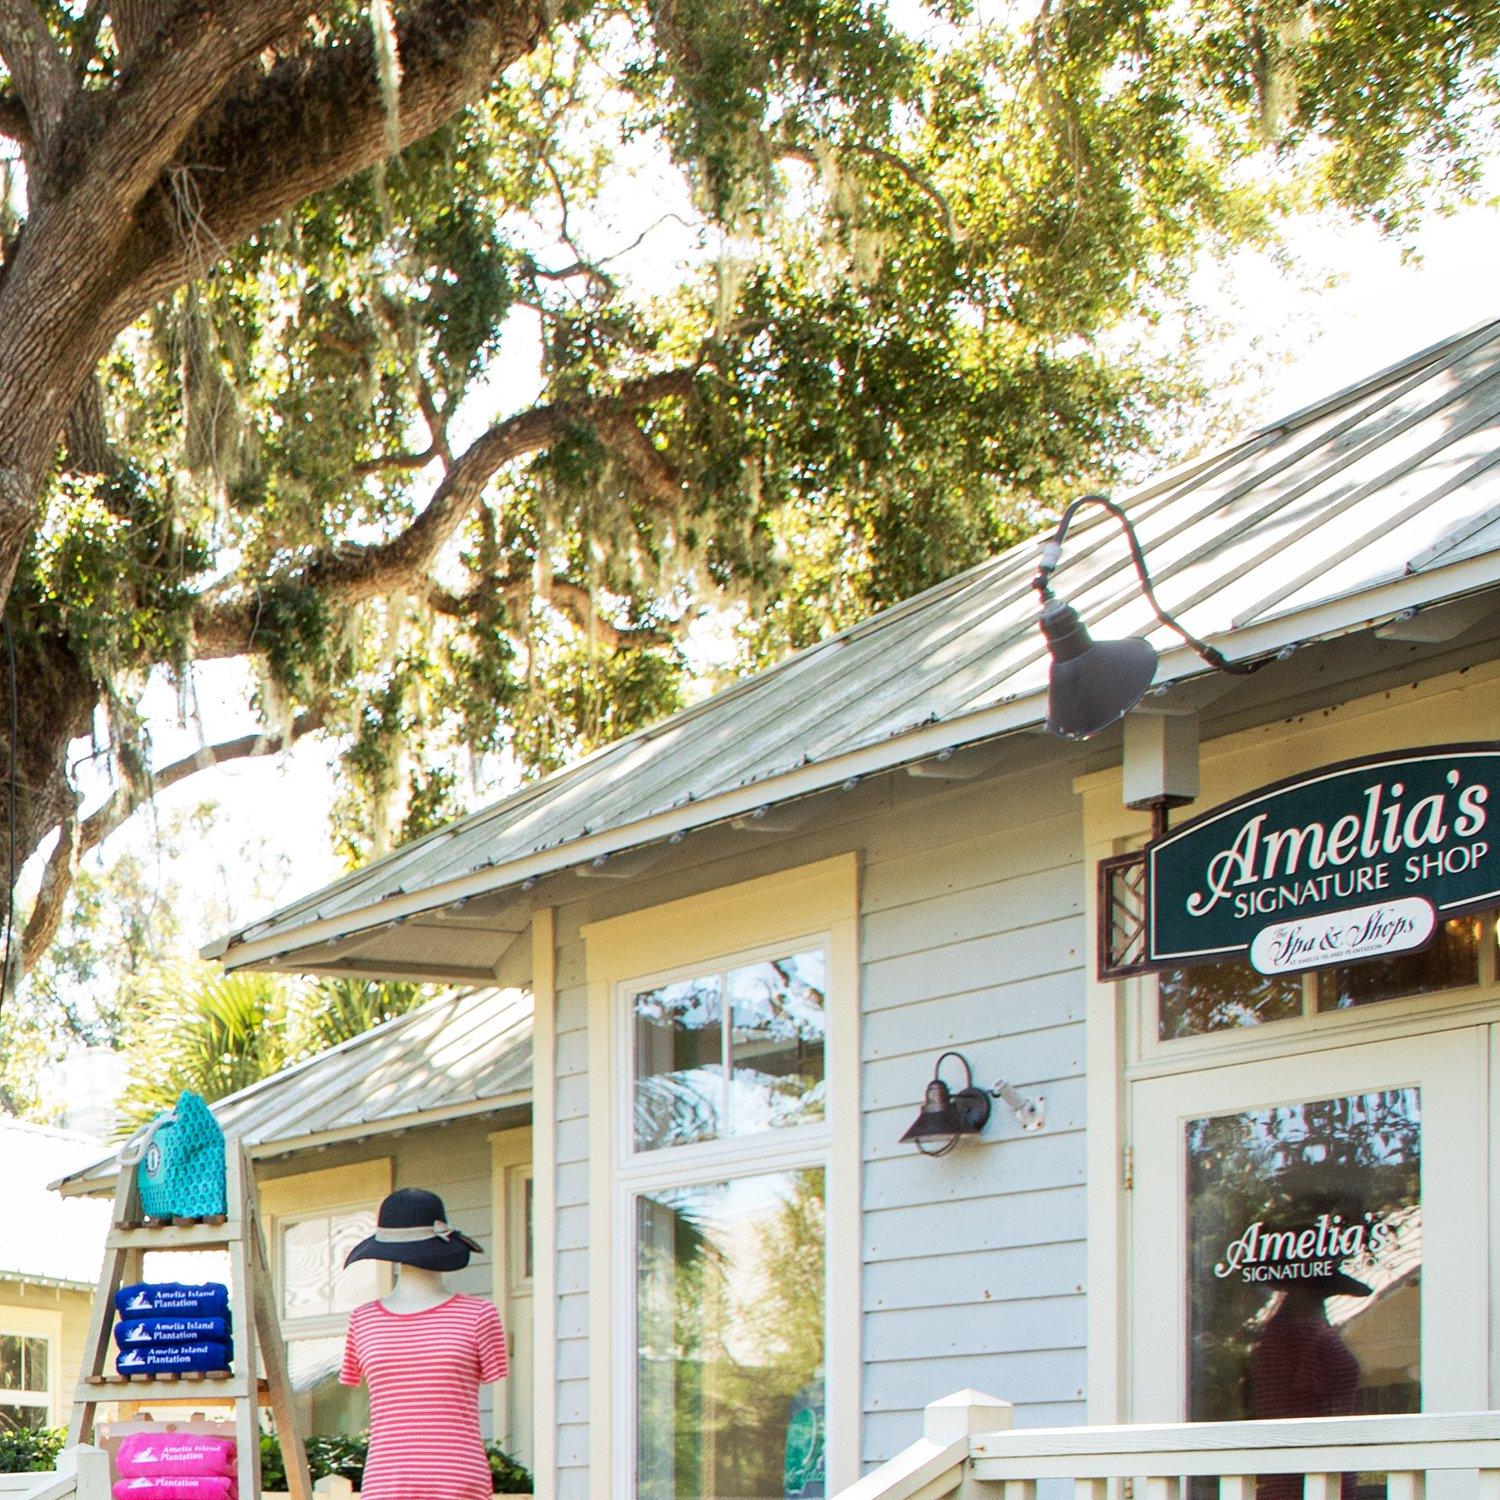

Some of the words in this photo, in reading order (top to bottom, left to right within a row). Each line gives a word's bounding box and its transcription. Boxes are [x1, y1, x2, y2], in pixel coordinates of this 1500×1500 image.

[1186, 769, 1490, 917] Amelia's
[1234, 862, 1390, 918] SIGNATURE
[1404, 841, 1489, 883] SHOP
[1269, 926, 1315, 967] Spa
[1319, 926, 1342, 951] &
[1346, 907, 1416, 947] Shops
[1214, 1211, 1388, 1278] Amelia's
[1242, 1260, 1333, 1283] SIGNATURE
[155, 1290, 186, 1299] Amelia
[154, 1299, 197, 1308] Plantation
[187, 1321, 214, 1329] Island
[153, 1331, 197, 1340] Plantation
[147, 1355, 191, 1364] Plantation
[161, 1452, 203, 1461] Plantation
[155, 1479, 199, 1487] Plantation
